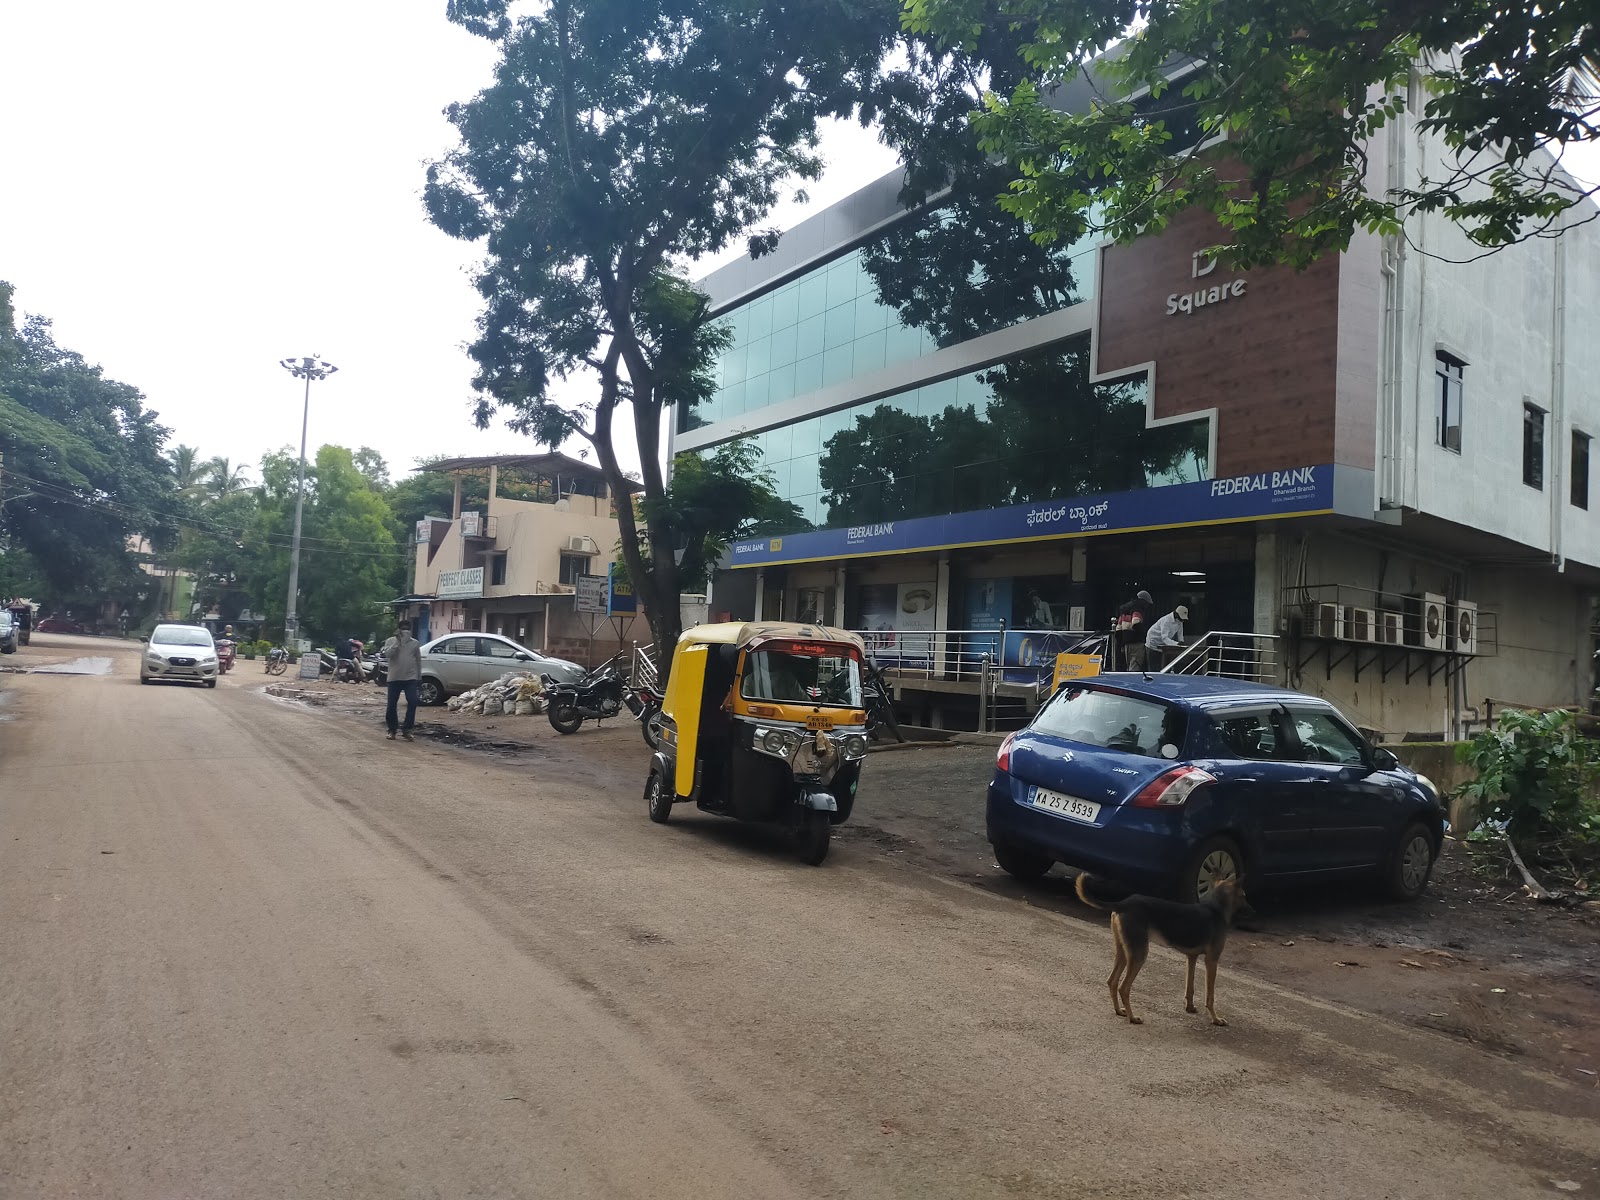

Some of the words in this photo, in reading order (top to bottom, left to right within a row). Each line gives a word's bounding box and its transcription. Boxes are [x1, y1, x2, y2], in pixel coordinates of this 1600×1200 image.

[1211, 473, 1268, 497] FEDERAL
[1271, 466, 1316, 489] BANK
[1273, 487, 1297, 496] Dharwad
[1297, 485, 1316, 493] Branch
[847, 526, 874, 540] FEDERAL
[874, 522, 895, 537] BANK
[735, 545, 752, 554] FEDERAL
[752, 543, 765, 552] BANK
[440, 571, 460, 587] PERFECT
[460, 569, 482, 585] CLASSES
[1112, 766, 1140, 776] SWIFT
[1035, 792, 1047, 805] KA
[1049, 796, 1062, 809] 25
[1062, 799, 1070, 811] Z
[1070, 801, 1094, 818] 9539
